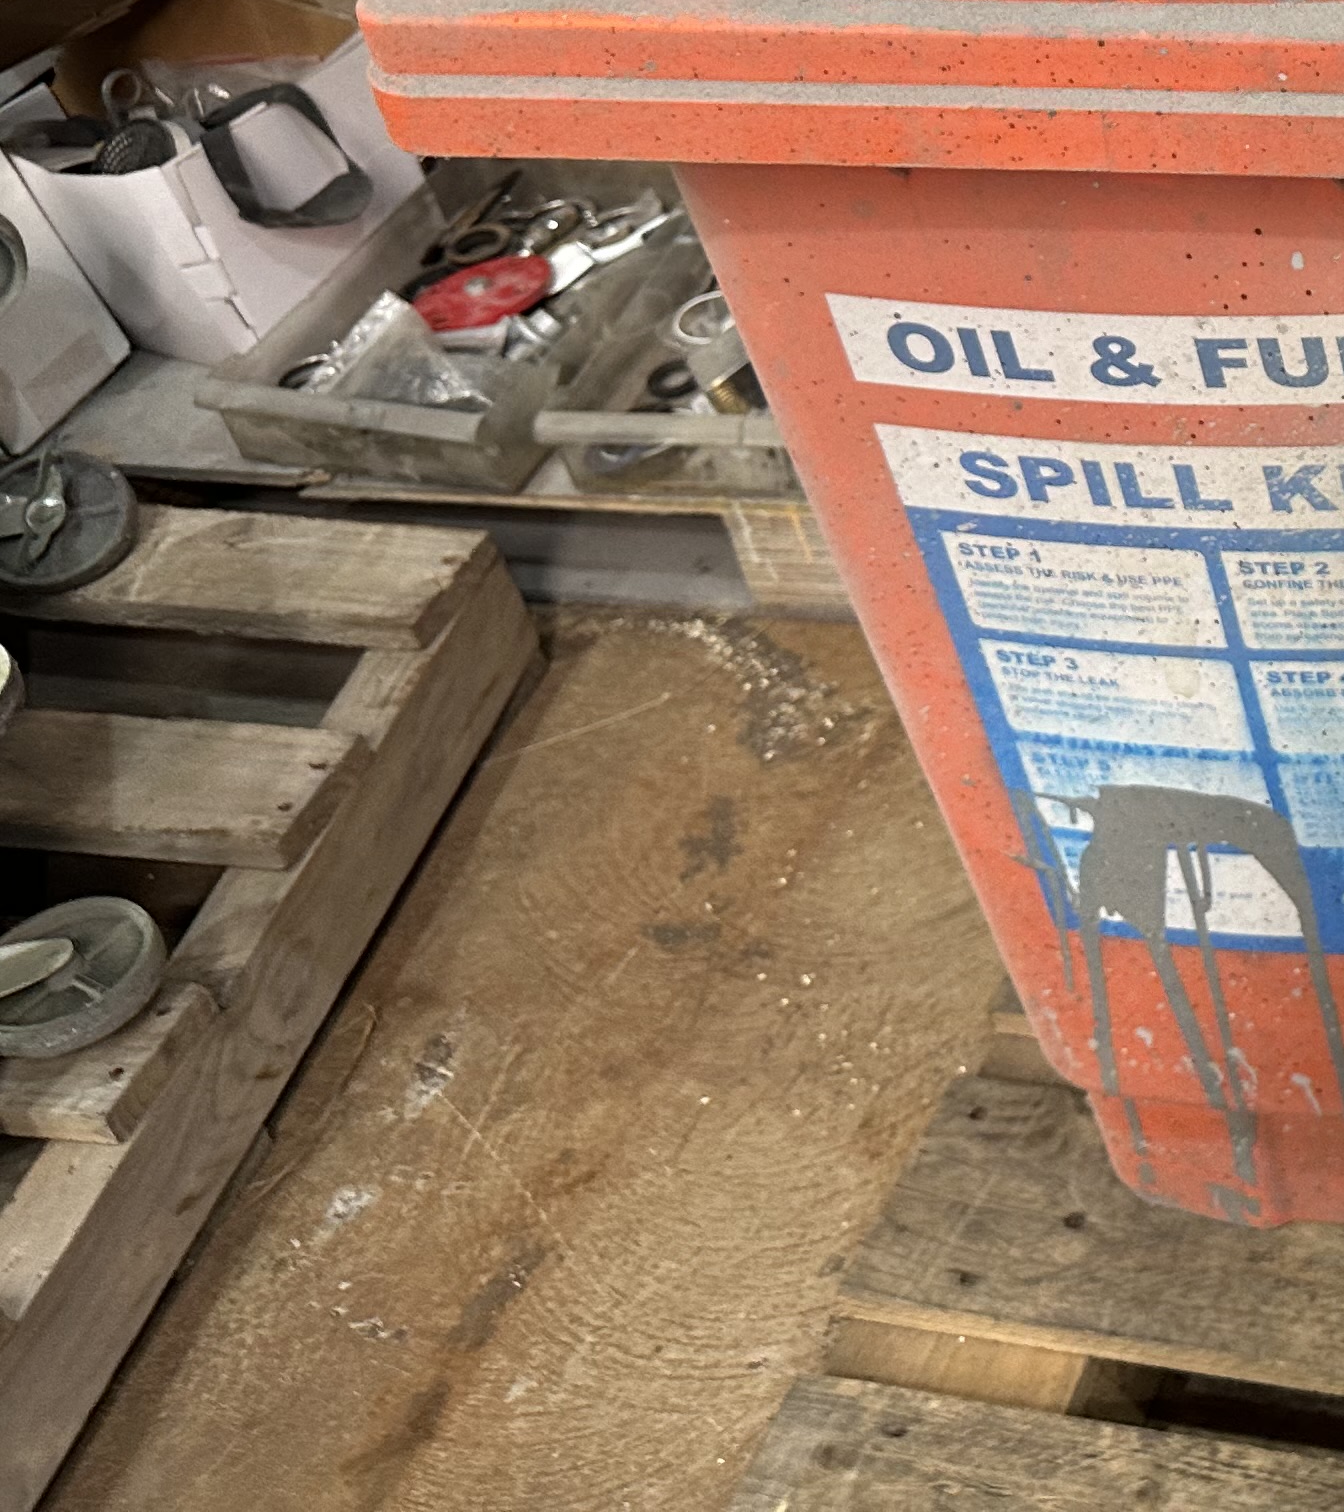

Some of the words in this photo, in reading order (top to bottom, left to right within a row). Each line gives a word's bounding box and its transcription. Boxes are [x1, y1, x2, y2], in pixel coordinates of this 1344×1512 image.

[887, 322, 1056, 382] OIL
[1090, 335, 1162, 388] &
[959, 451, 1234, 512] SPILL
[958, 542, 1021, 560] STEP
[1029, 547, 1041, 563] 1
[964, 560, 1024, 576] ASSESS
[1027, 566, 1054, 579] THE
[1062, 569, 1098, 582] RISK
[1116, 574, 1148, 586] USE
[1151, 575, 1184, 587] PPE
[1239, 560, 1306, 576] STEP
[1315, 561, 1331, 576] 2
[1243, 579, 1314, 590] CONFINE
[995, 649, 1057, 668] STEP
[1065, 657, 1080, 670] 3
[1001, 665, 1040, 678] STOP
[1044, 671, 1075, 683] THE
[1079, 675, 1120, 687] LEAK
[1266, 670, 1332, 684] STEP
[1271, 687, 1337, 698] ABSORB
